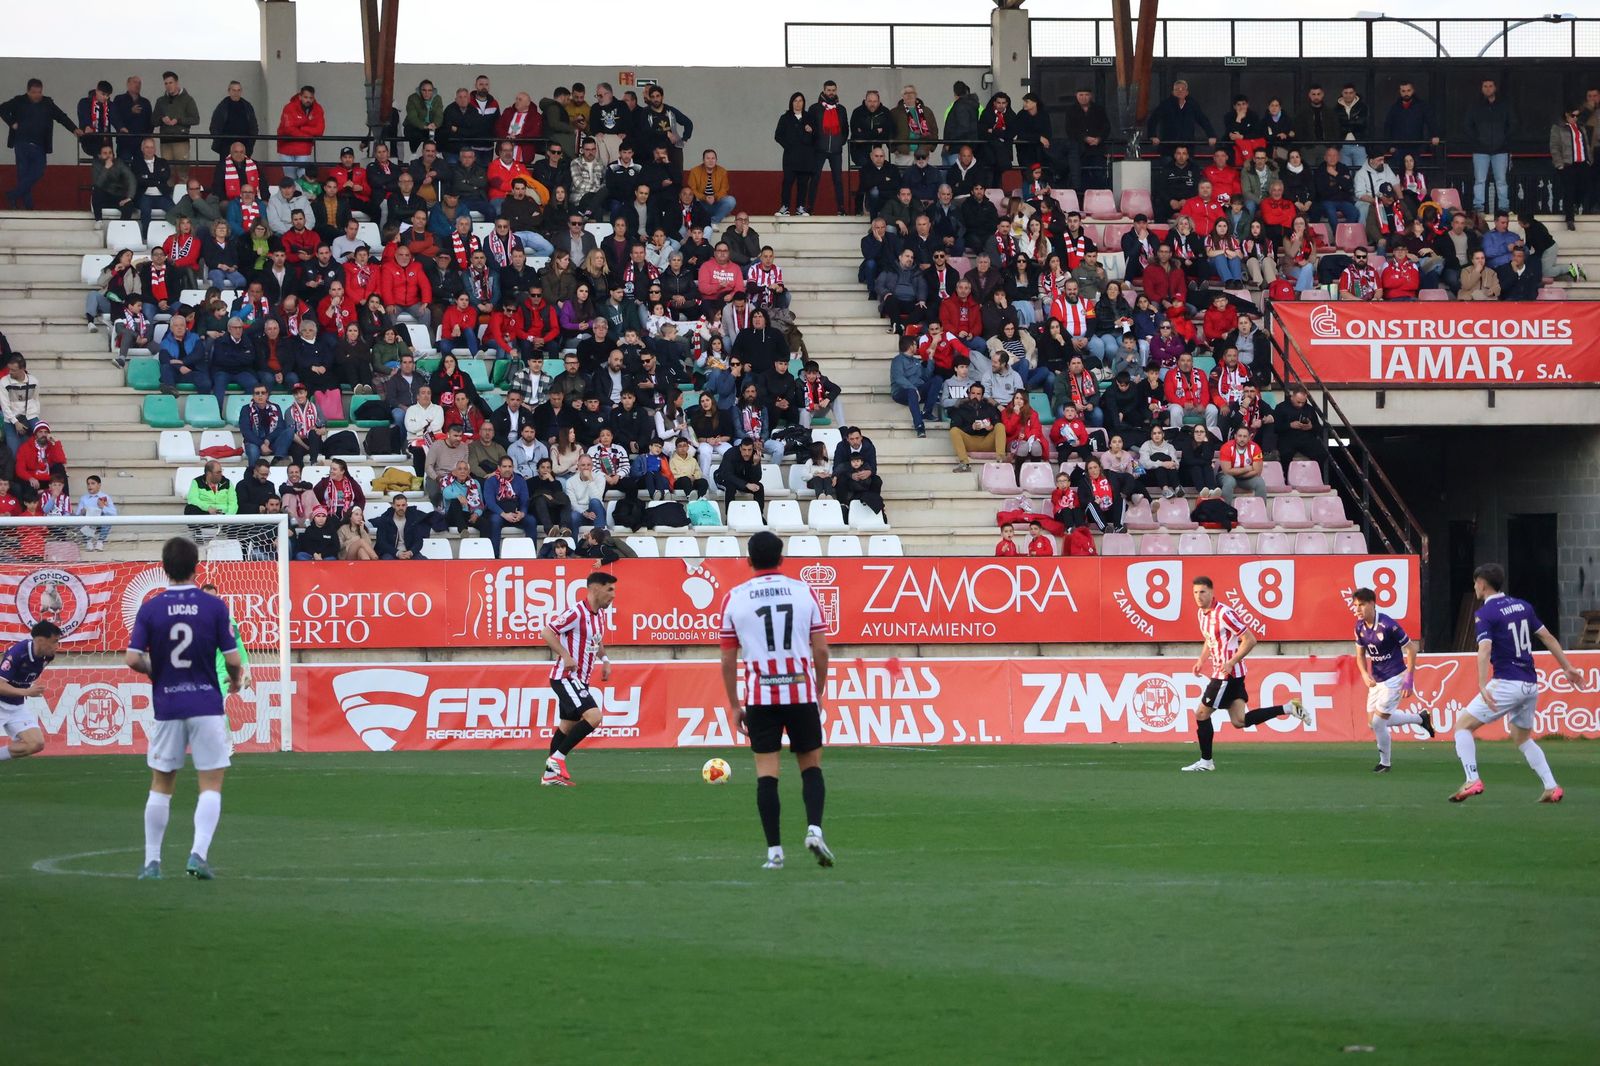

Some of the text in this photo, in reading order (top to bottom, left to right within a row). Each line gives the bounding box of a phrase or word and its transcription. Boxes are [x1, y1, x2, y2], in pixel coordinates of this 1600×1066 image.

[1536, 363, 1572, 379] S.A.
[948, 386, 969, 399] NIK
[33, 572, 70, 583] FONDO
[750, 587, 792, 599] CARBONELL
[862, 564, 1078, 614] ZAMORA
[1146, 568, 1170, 610] 8
[1258, 567, 1283, 609] 8
[168, 604, 198, 616] LUCAS
[303, 584, 432, 617] ÓPTICO
[1113, 588, 1154, 637] ZAMORA
[1225, 587, 1267, 636] ZAMORA
[632, 607, 721, 640] podoac
[651, 630, 699, 640] PODOLOGÍA
[755, 603, 793, 652] 17
[861, 622, 996, 637] AYUNTAMIENTO
[1508, 619, 1532, 658] 14
[169, 622, 193, 669] 2
[1260, 671, 1340, 734] CF
[426, 729, 531, 739] REFRIGERACION
[952, 719, 1002, 742] S.L.
